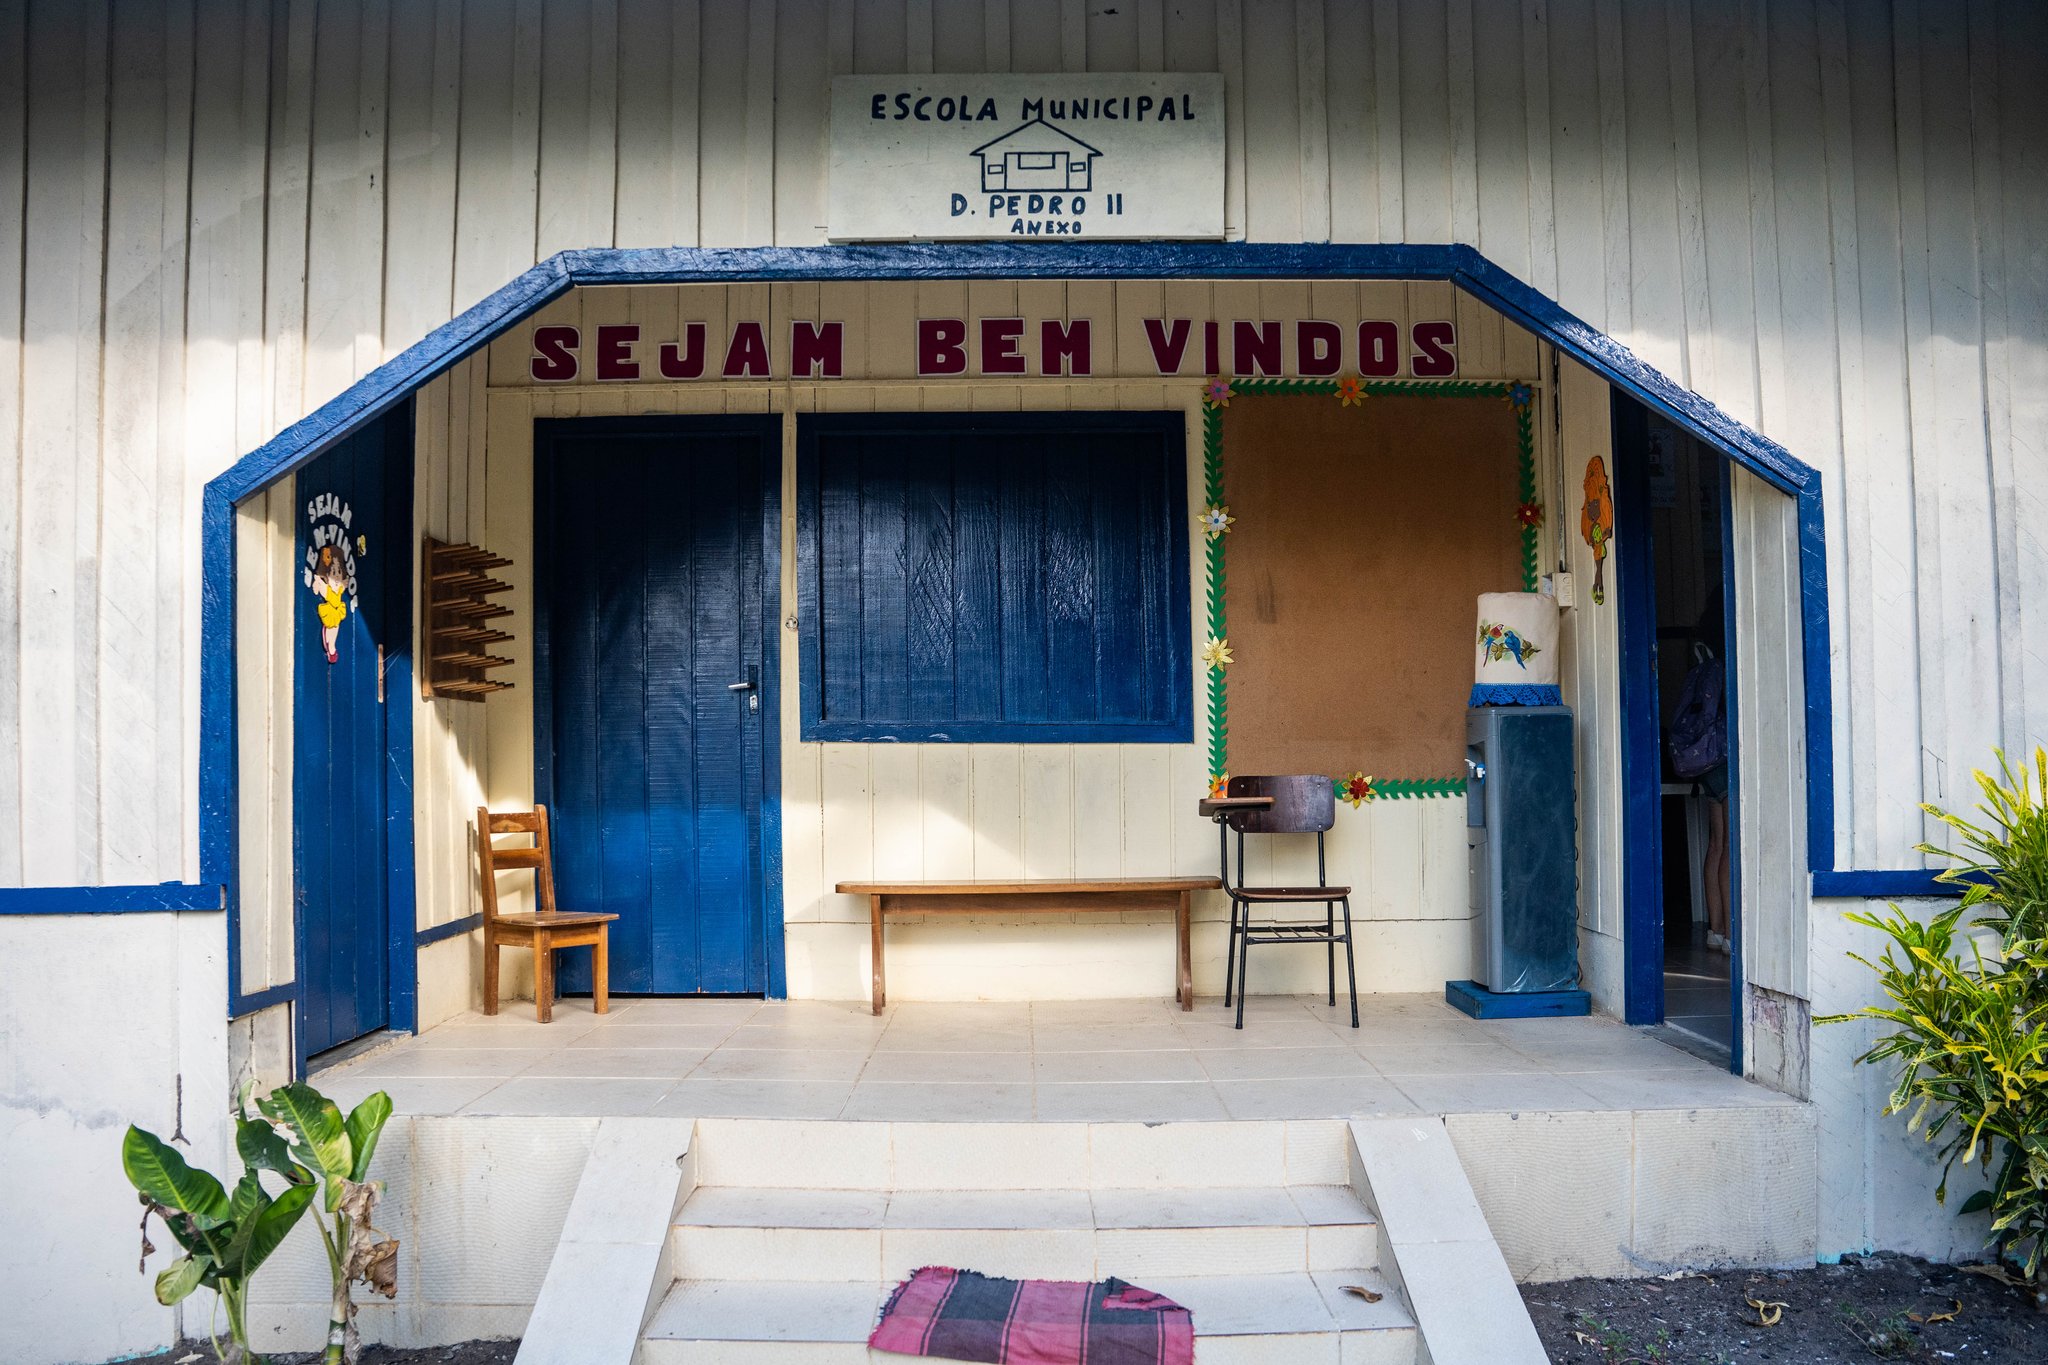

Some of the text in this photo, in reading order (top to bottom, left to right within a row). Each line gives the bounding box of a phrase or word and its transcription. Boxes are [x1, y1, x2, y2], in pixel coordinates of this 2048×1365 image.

[870, 93, 1195, 122] ESCOLA MUNICIPAL
[950, 193, 1123, 218] D. PEDRO II
[1010, 218, 1082, 235] ANEXO
[530, 317, 1457, 382] SEJAM BEM VINDOS
[308, 492, 353, 529] SEJAM
